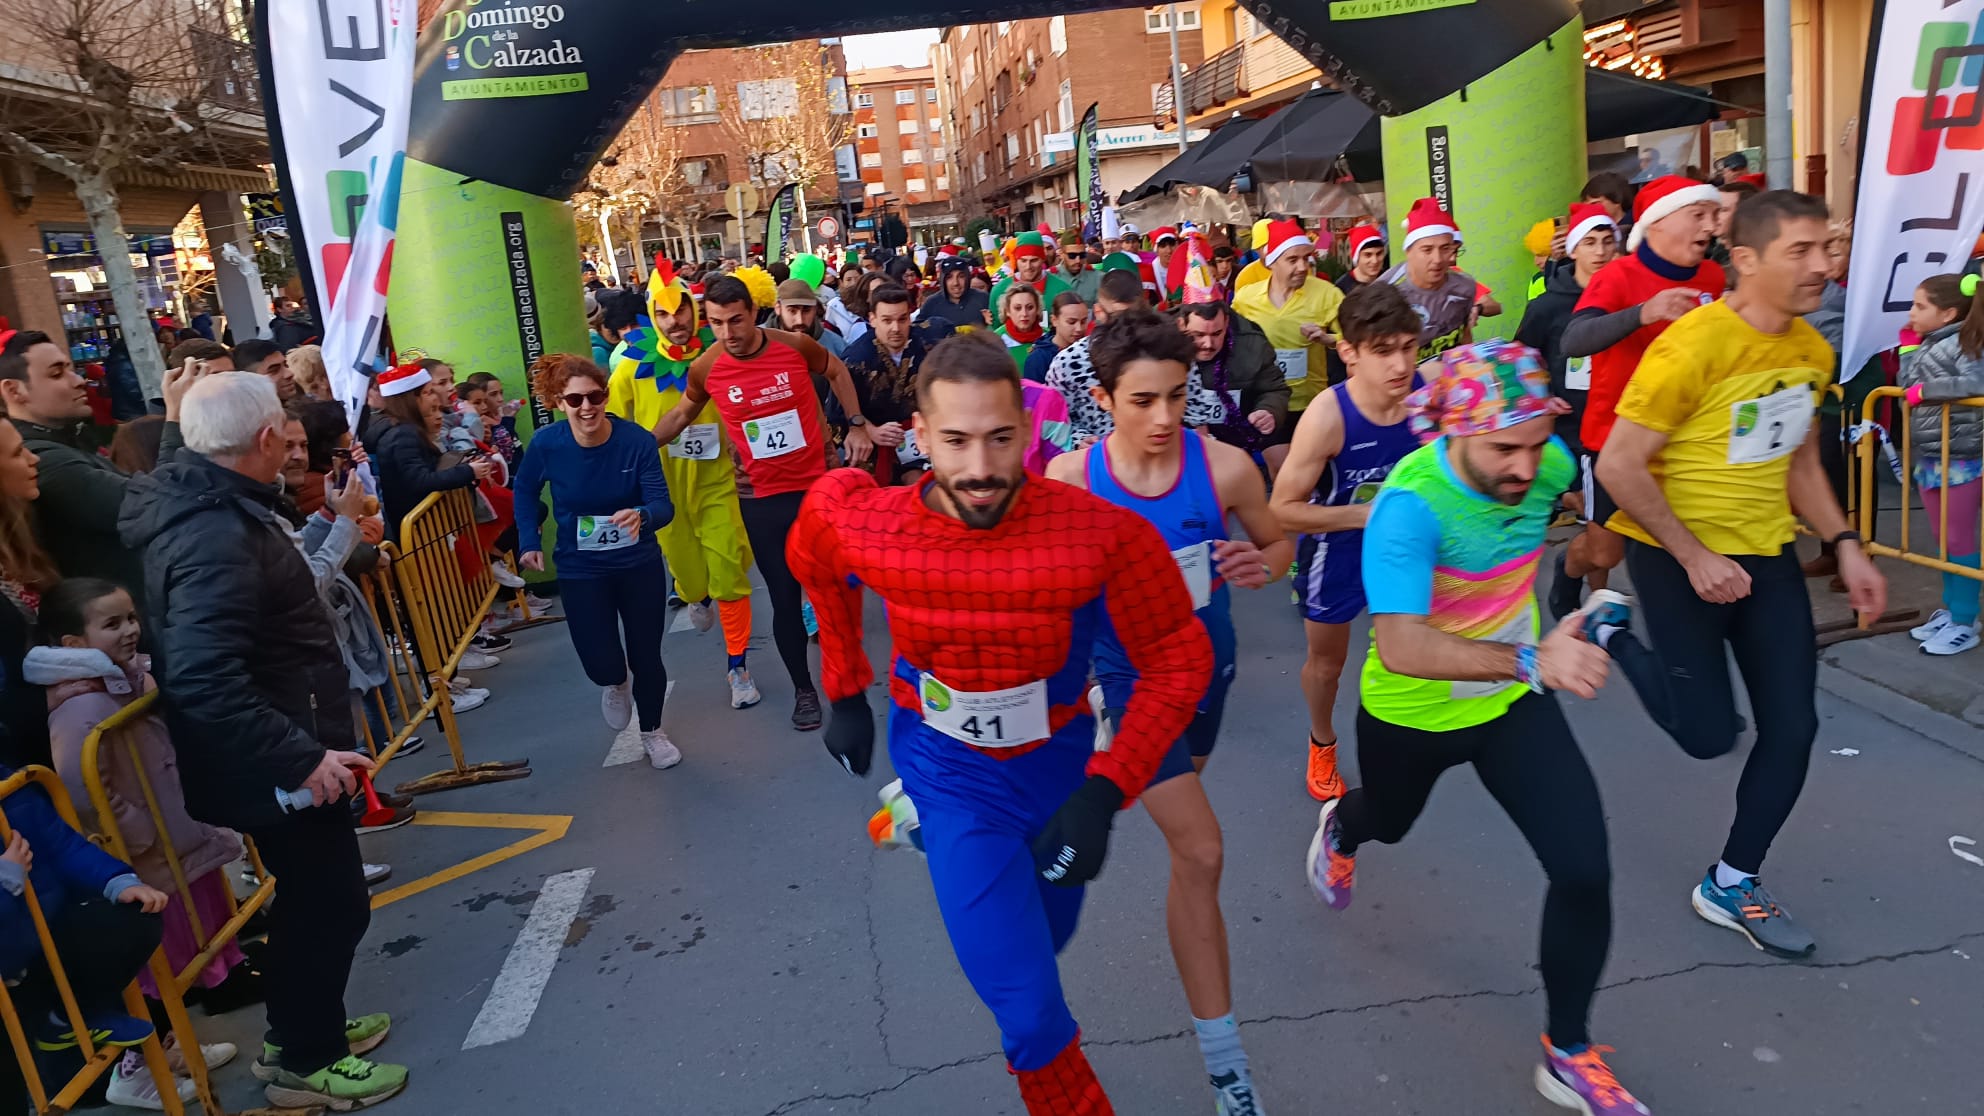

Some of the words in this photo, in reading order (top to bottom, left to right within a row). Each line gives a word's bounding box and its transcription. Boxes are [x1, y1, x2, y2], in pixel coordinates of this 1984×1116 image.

[442, 1, 565, 41] Domingo
[492, 30, 506, 41] de
[507, 29, 519, 40] la
[464, 35, 583, 69] Calzada
[451, 78, 580, 95] AYUNTAMIENTO
[767, 430, 788, 450] 42
[1767, 421, 1785, 450] 2
[684, 440, 703, 455] 53
[598, 529, 620, 545] 43
[960, 715, 1004, 740] 41
